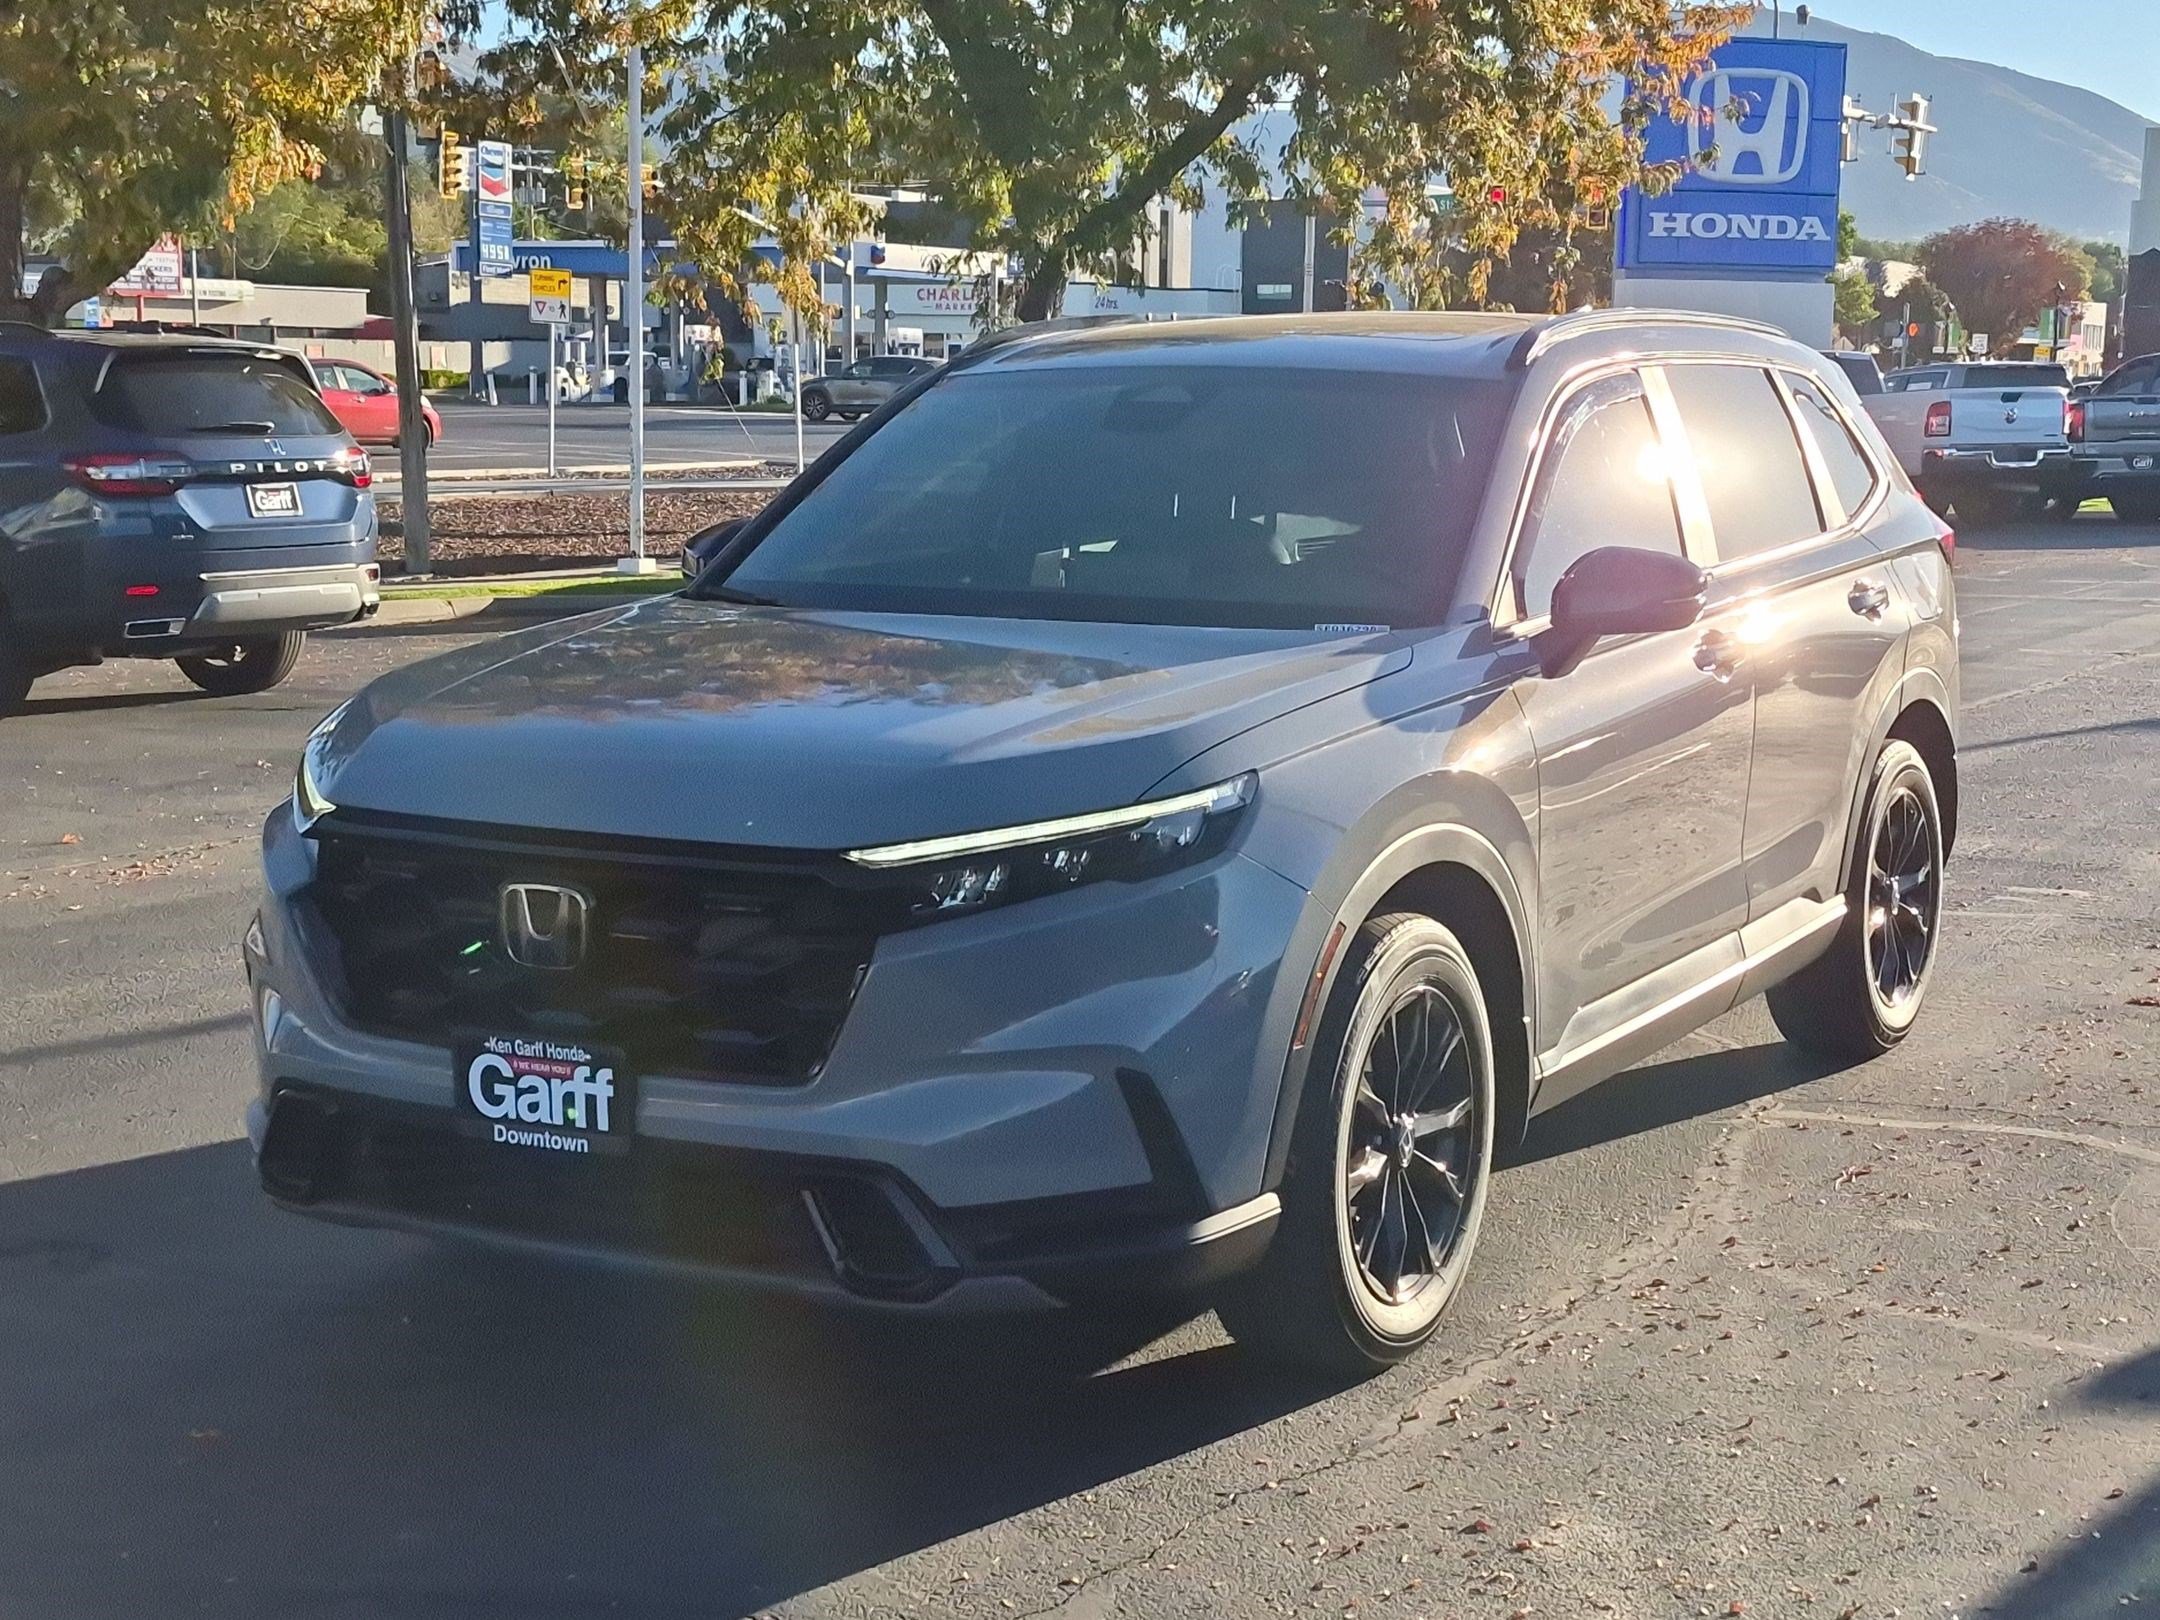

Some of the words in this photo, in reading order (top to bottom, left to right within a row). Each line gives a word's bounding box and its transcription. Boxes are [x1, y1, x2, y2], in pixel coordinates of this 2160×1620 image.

[1648, 212, 1831, 241] HONDA
[512, 255, 551, 269] vron
[917, 287, 975, 302] CHARLI
[935, 303, 973, 311] MARKE
[230, 460, 327, 474] PILOT
[255, 489, 293, 510] Garff
[468, 1053, 614, 1132] Garff
[493, 1125, 589, 1153] Downtown
